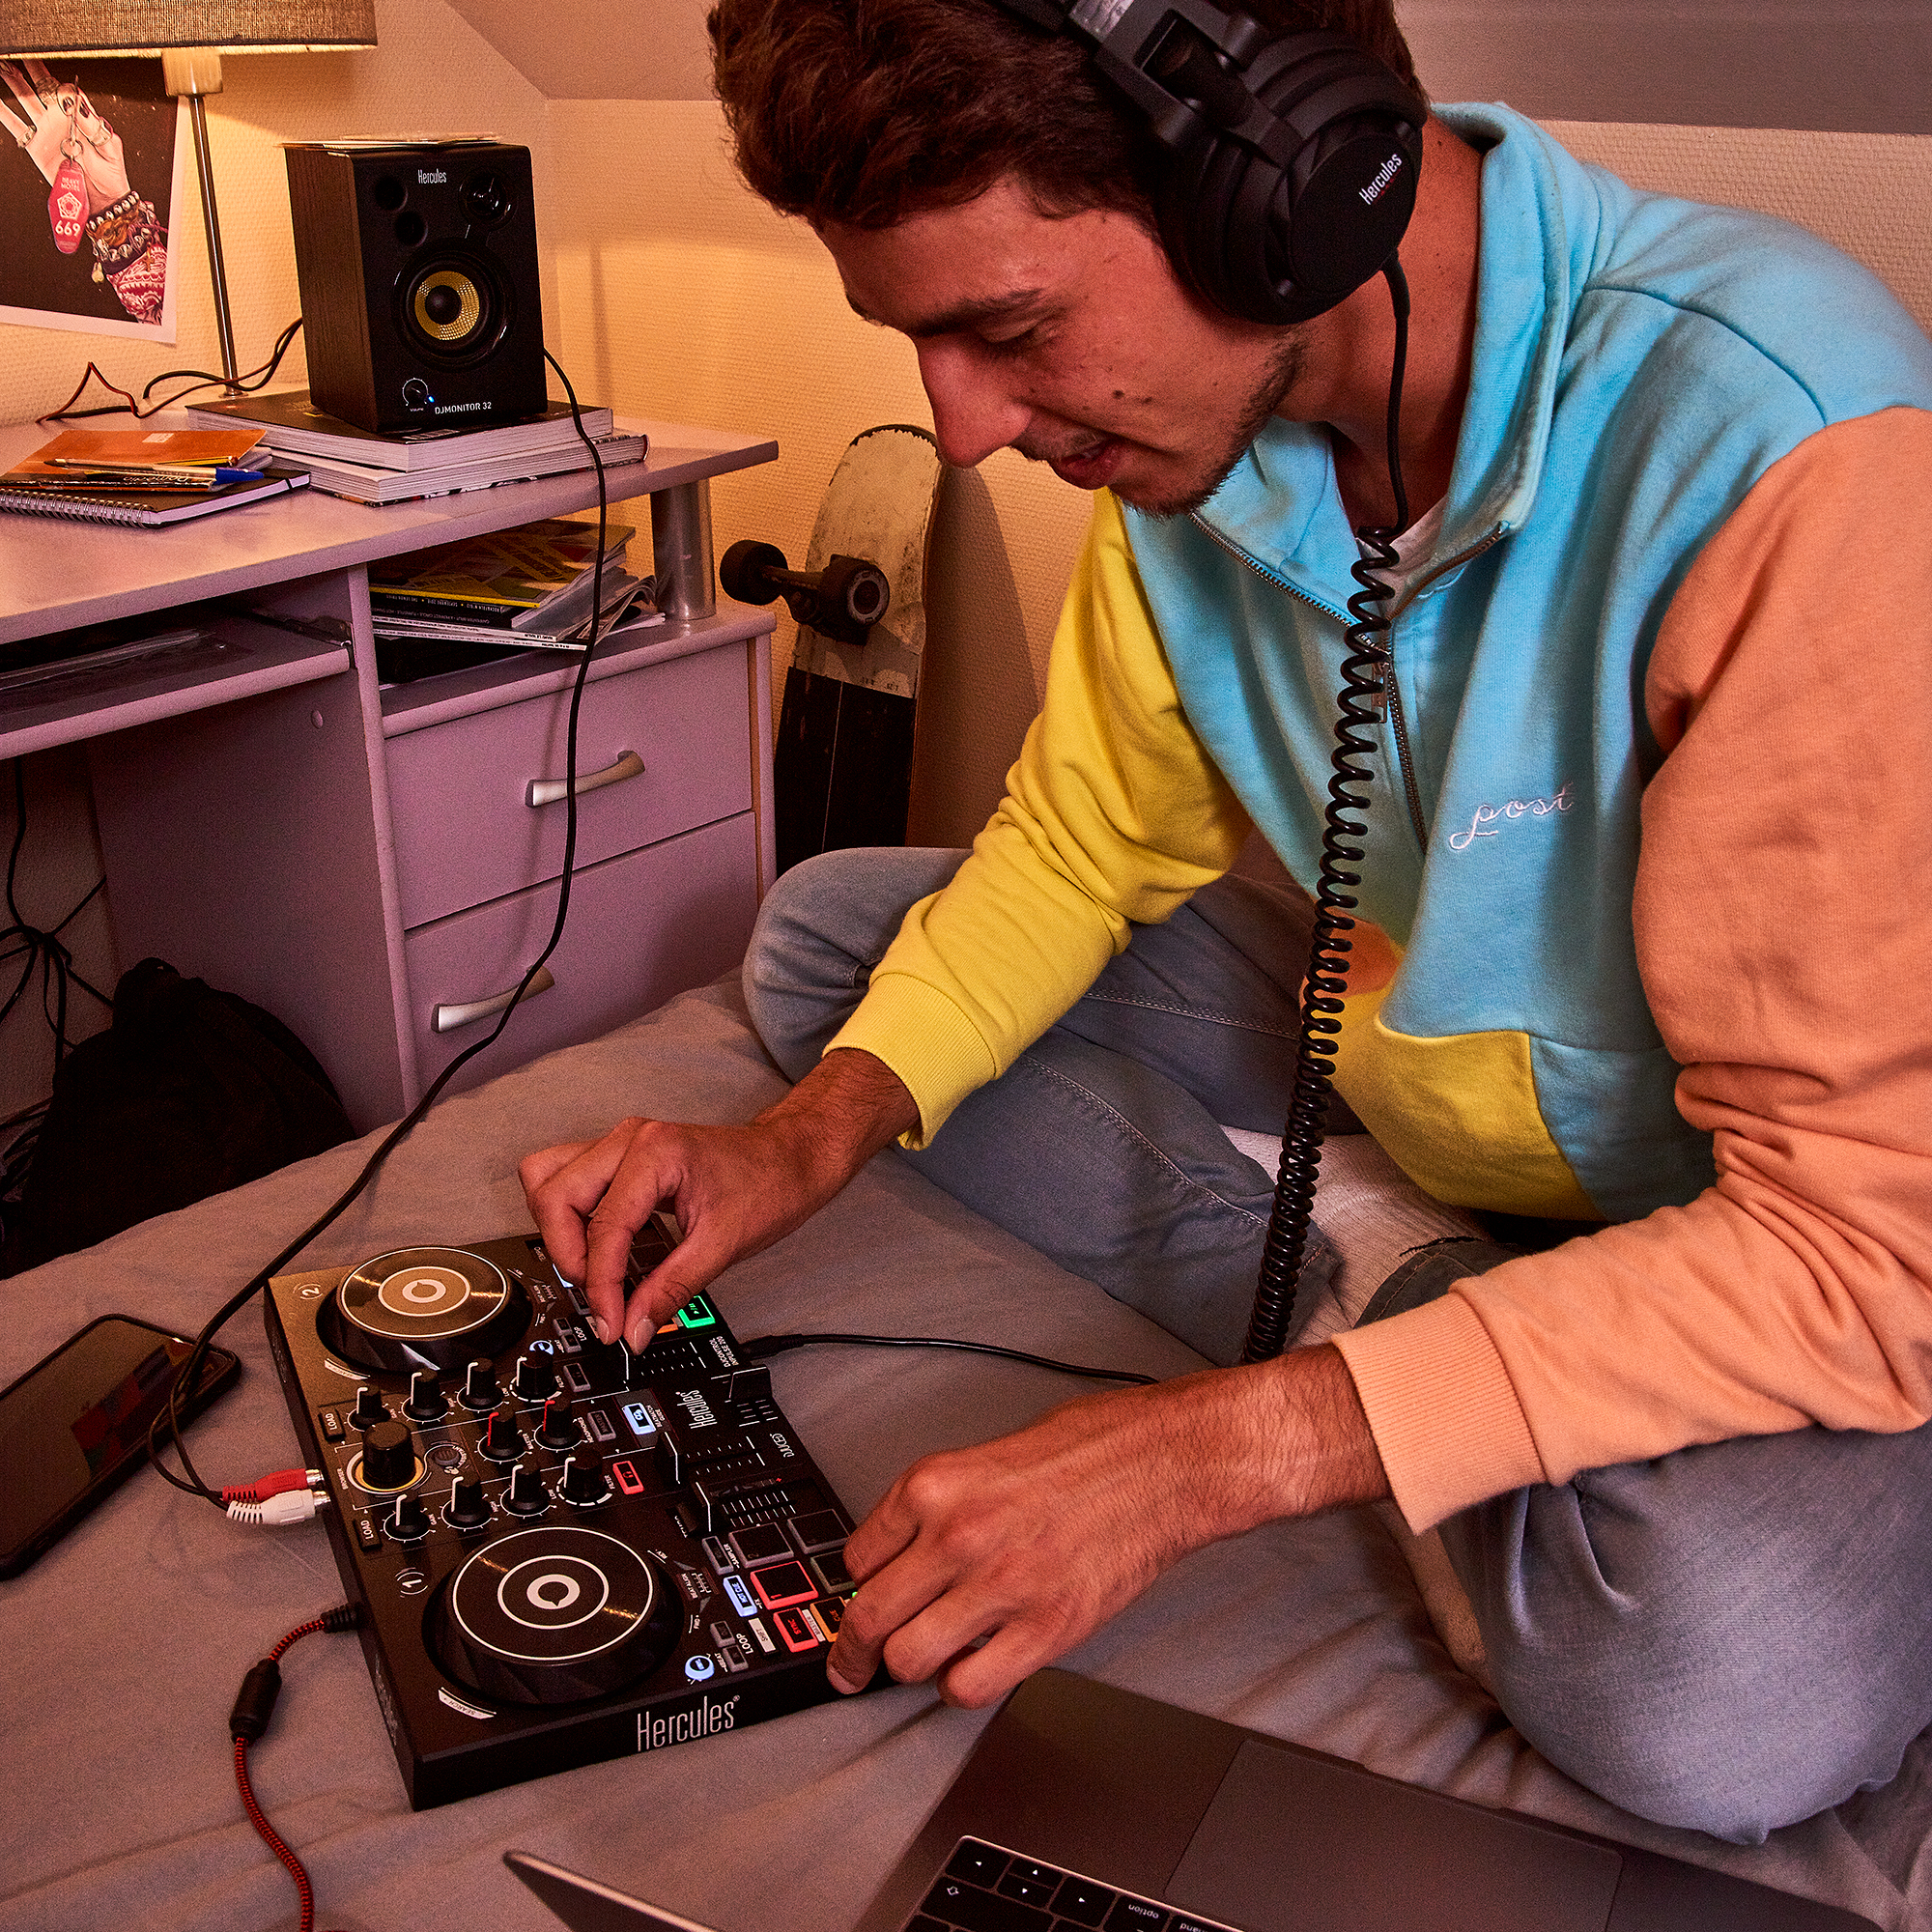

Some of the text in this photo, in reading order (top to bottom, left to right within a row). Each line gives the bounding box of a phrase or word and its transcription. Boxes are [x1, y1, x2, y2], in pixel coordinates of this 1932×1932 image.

[417, 168, 446, 184] Hercules
[1358, 154, 1403, 205] Hercules
[56, 220, 80, 236] 669
[435, 403, 481, 414] DJMONITOR
[1449, 782, 1575, 849] post
[302, 1288, 320, 1296] 2
[574, 1326, 587, 1341] LOOP
[676, 1389, 718, 1430] Hercules
[325, 1412, 337, 1431] LOAD
[578, 1416, 594, 1443] HEADPHONES
[336, 1468, 349, 1490] BROWSER
[605, 1474, 615, 1490] FILTER
[548, 1489, 557, 1499] LOW
[360, 1520, 374, 1540] LOAD
[402, 1578, 423, 1588] 1
[688, 1587, 698, 1599] BEAT
[732, 1582, 748, 1604] HOT CUE
[829, 1609, 840, 1622] CUE
[787, 1618, 802, 1635] SYNC
[806, 1615, 821, 1635] MASTER
[755, 1628, 768, 1642] SHIFT
[736, 1633, 753, 1654] LOOP
[448, 1700, 476, 1717] SEARCH
[1128, 1904, 1159, 1918] option
